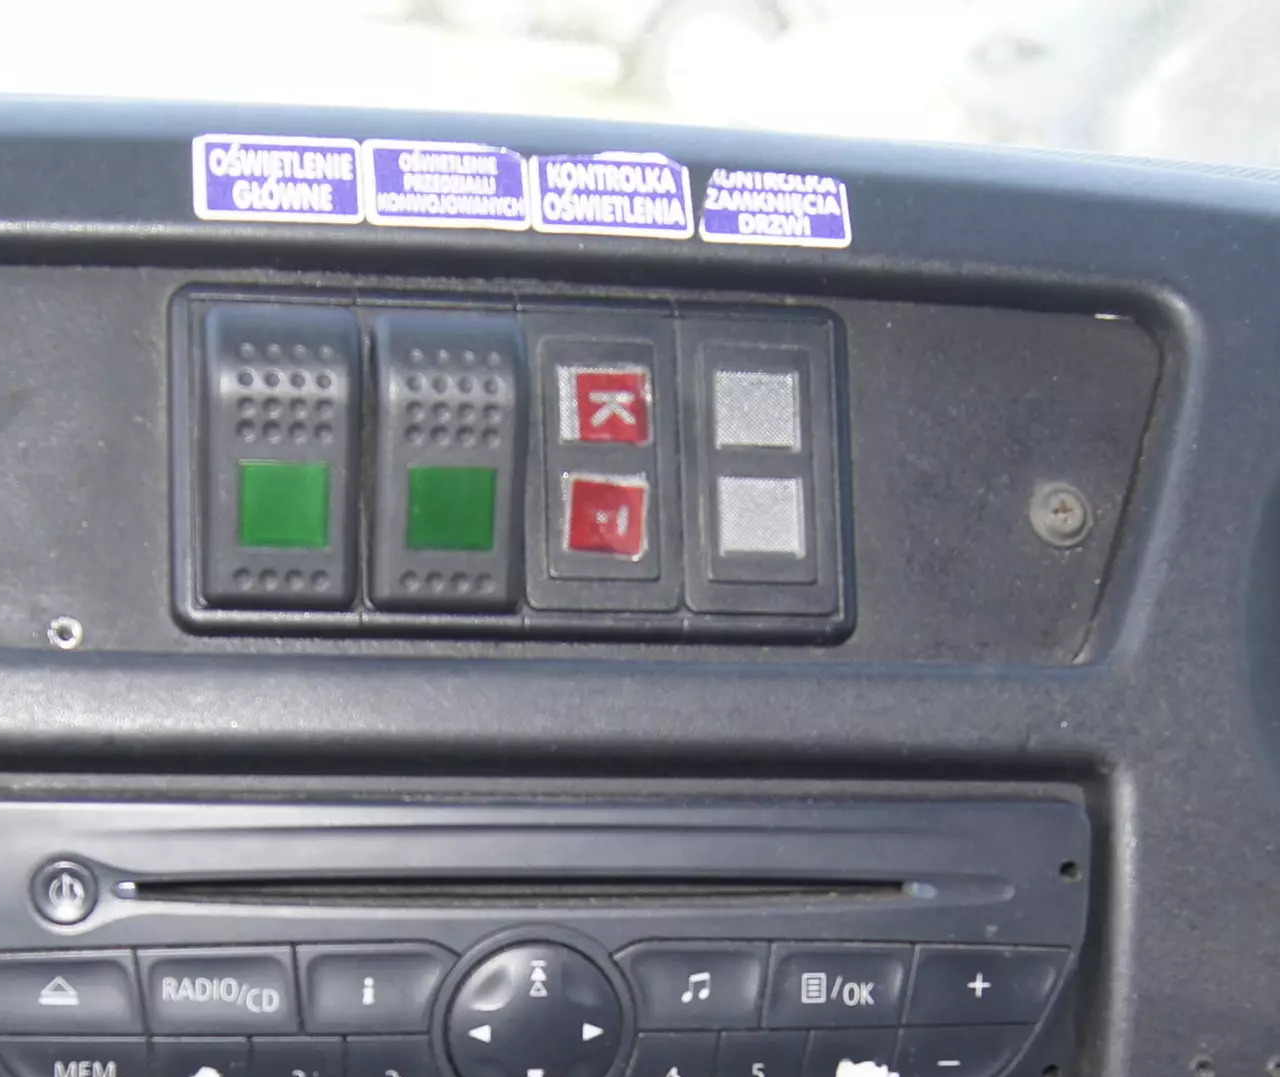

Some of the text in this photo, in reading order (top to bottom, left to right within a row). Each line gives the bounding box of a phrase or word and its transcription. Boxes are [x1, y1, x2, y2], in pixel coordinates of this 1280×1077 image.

[208, 143, 354, 180] OŚWIETLENIE
[547, 162, 677, 194] KONTROLKA
[232, 177, 333, 211] GŁÓWNE
[543, 189, 685, 225] OŚWIETLENIA
[738, 213, 811, 236] DRZWI
[588, 391, 635, 427] K
[161, 976, 280, 1013] RADIO/CD
